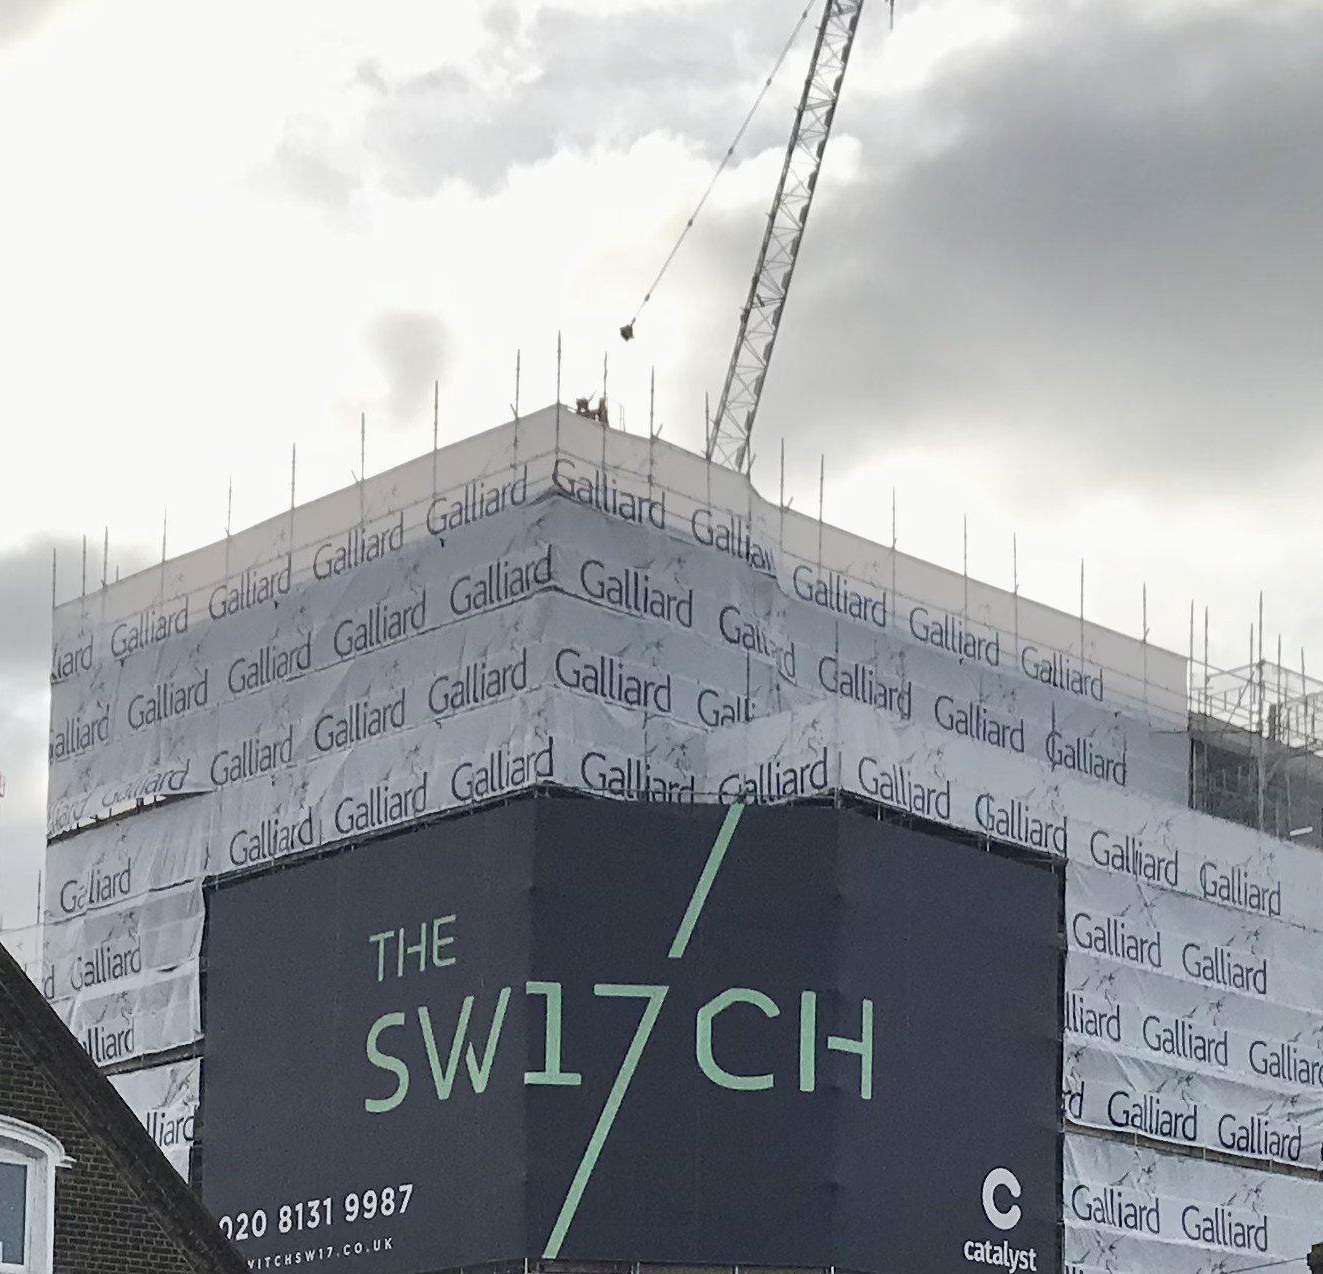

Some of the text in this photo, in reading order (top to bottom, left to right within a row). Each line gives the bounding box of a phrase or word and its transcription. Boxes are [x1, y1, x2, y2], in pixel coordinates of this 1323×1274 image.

[111, 596, 189, 657] Galliard
[209, 552, 291, 620] Galliard
[313, 511, 404, 580] Galliard
[426, 464, 527, 535] Galliard
[552, 458, 666, 529] Galliard
[793, 564, 887, 628] Galliard
[909, 606, 1000, 667] Galliard
[1021, 646, 1103, 701] Galliard
[128, 669, 208, 730] Galliard
[228, 632, 312, 694] Galliard
[333, 590, 426, 658] Galliard
[450, 544, 552, 616] Galliard
[580, 560, 693, 628] Galliard
[818, 656, 912, 720] Galliard
[935, 696, 1024, 753] Galliard
[1045, 729, 1127, 787] Galliard
[210, 725, 293, 787] Galliard
[314, 688, 405, 752] Galliard
[428, 647, 527, 715] Galliard
[555, 648, 671, 713] Galliard
[229, 806, 314, 866] Galliard
[335, 771, 427, 834] Galliard
[451, 736, 553, 801] Galliard
[581, 752, 694, 804] Galliard
[858, 757, 1281, 916] Galliard Galliard Galliard Galliard
[369, 914, 457, 982] THE
[1073, 913, 1267, 995] Galliard Galliard
[1143, 1014, 1228, 1067] Galliard
[1107, 1089, 1198, 1142] Galliard
[1218, 1113, 1301, 1161] Galliard
[219, 1183, 414, 1240] 020 8131 9987
[1071, 1183, 1268, 1252] Galliard Galliard
[963, 1240, 1037, 1274] catalyst
